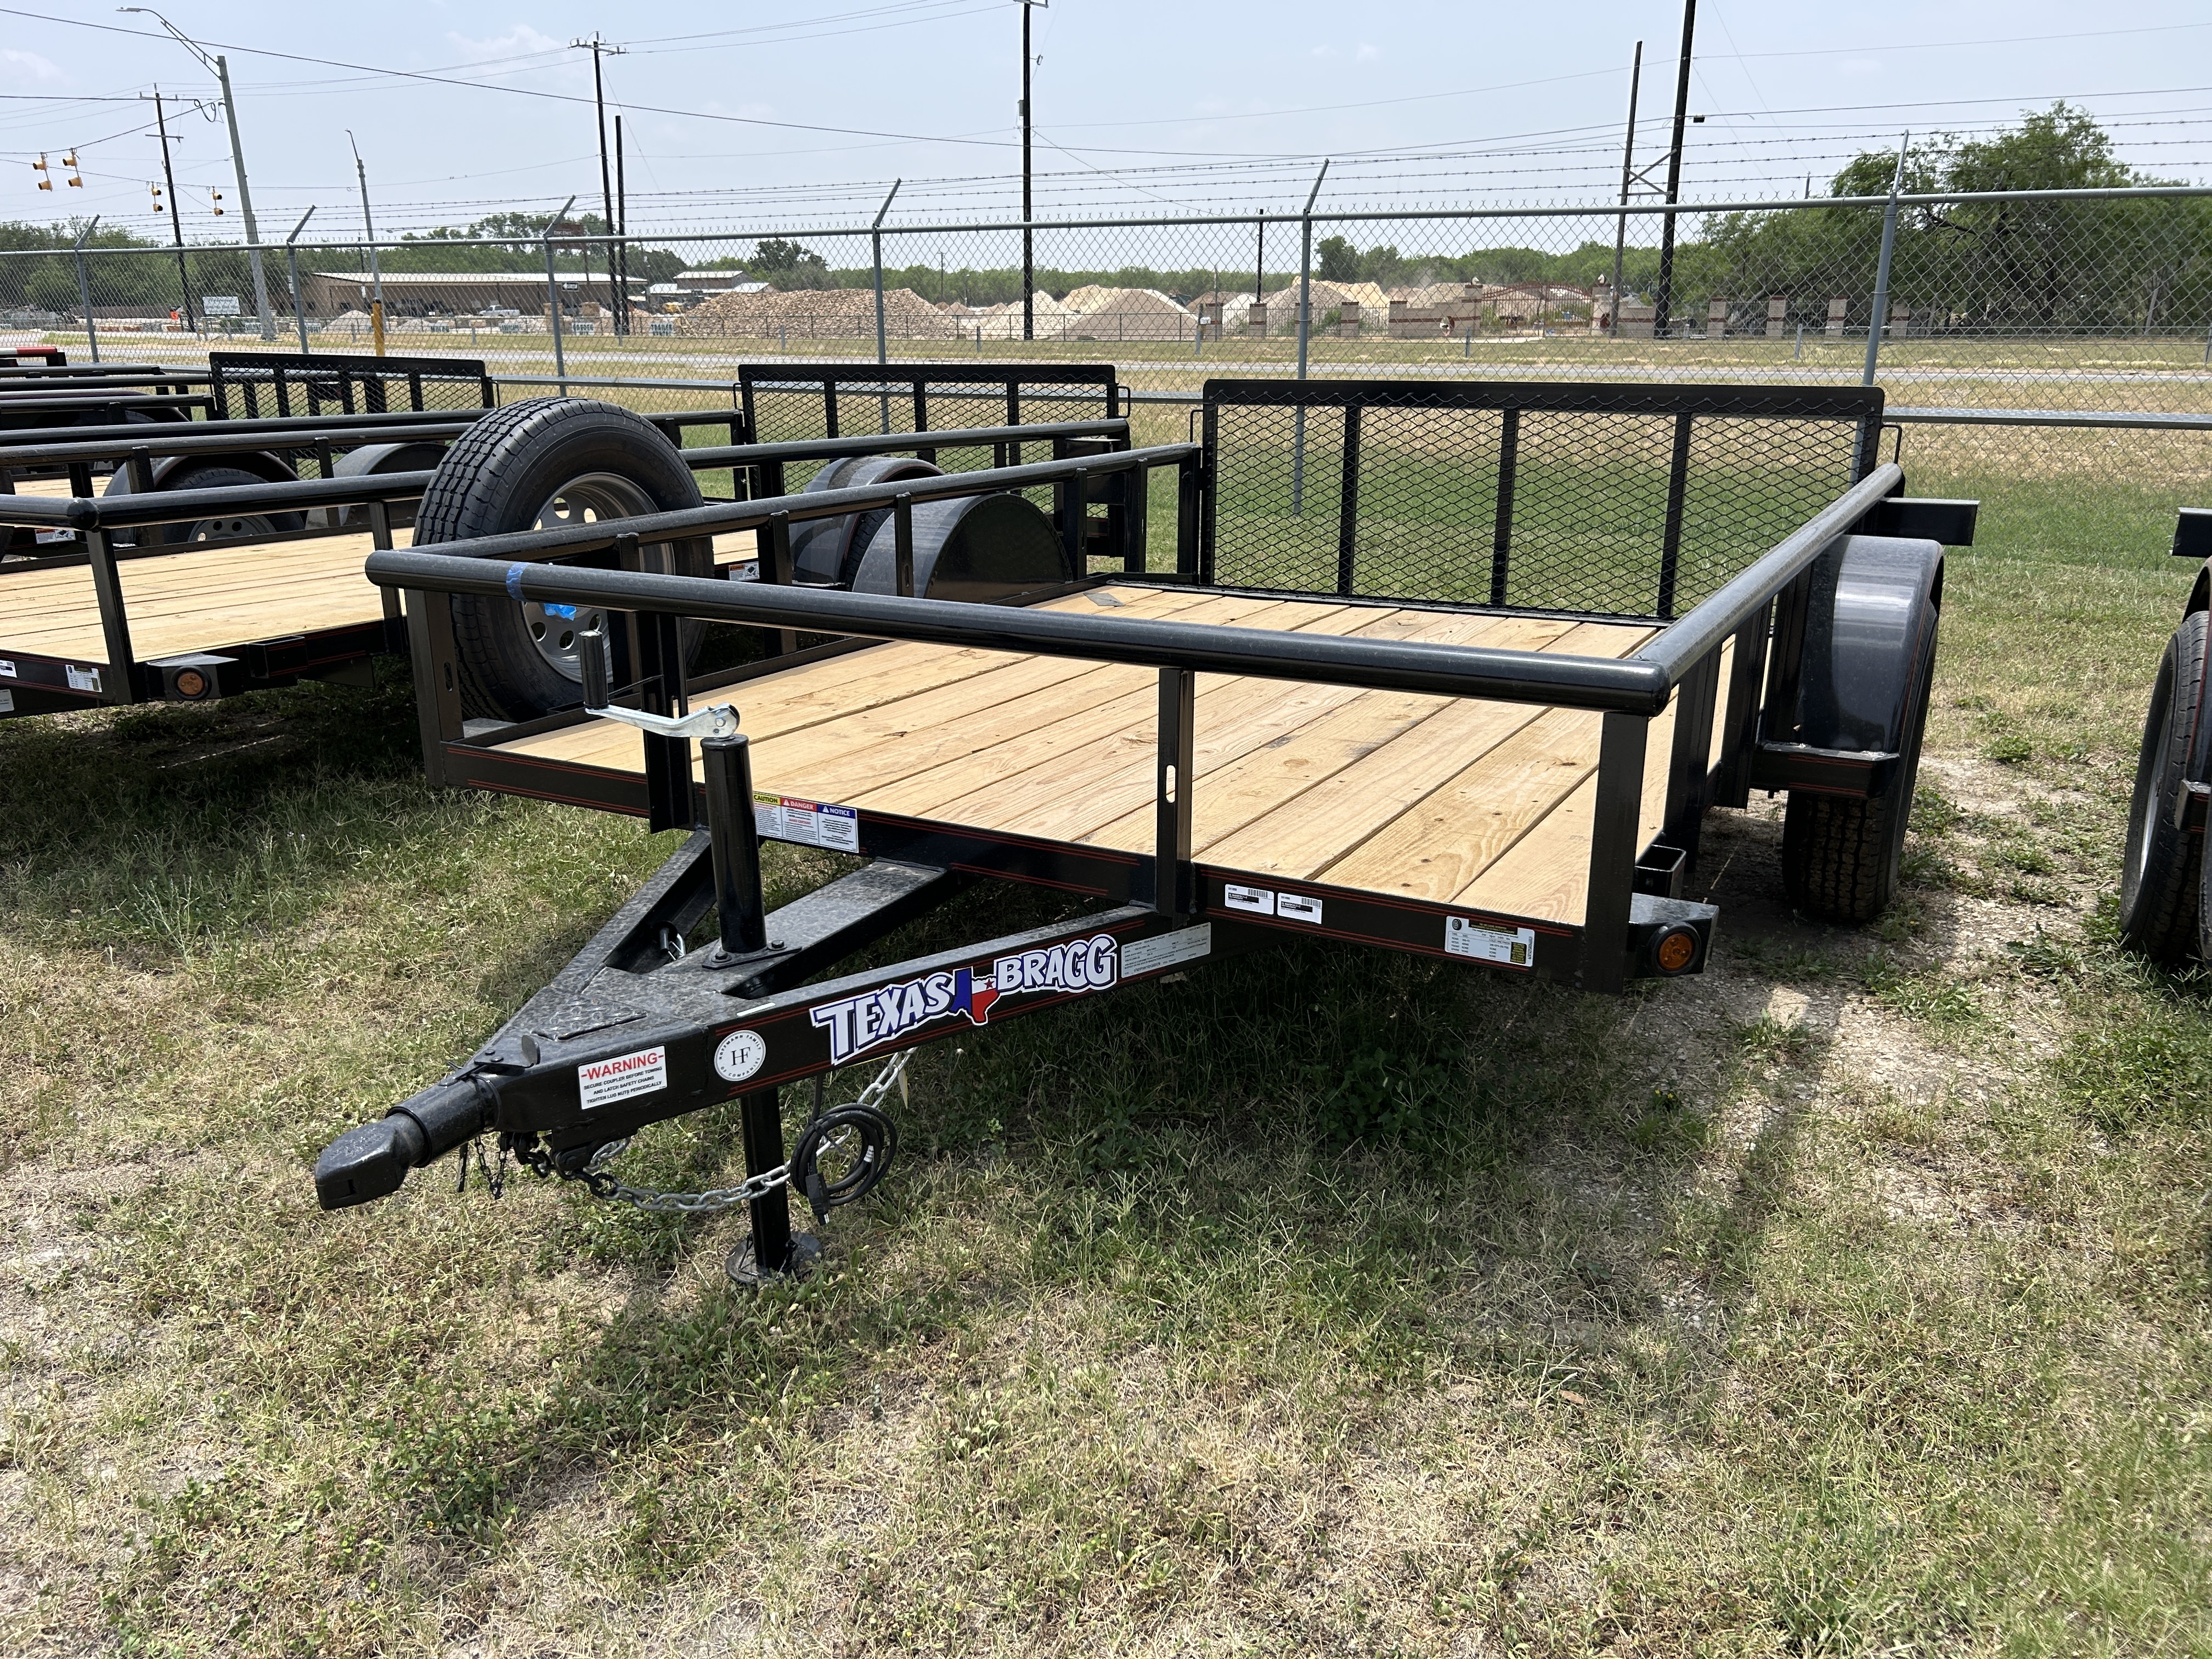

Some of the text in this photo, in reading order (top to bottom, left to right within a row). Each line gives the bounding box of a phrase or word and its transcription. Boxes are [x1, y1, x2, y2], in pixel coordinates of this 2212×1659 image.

[753, 794, 778, 804] CAUTION
[790, 800, 814, 810] DANGER
[830, 808, 850, 816] NOTICE
[811, 973, 955, 1064] TEXAS
[994, 934, 1116, 994] BRAGG
[746, 1035, 761, 1050] FAMILY
[731, 1047, 751, 1066] HF
[729, 1057, 760, 1077] COMPANIES
[584, 1066, 663, 1090] SECURE COUPLER BEFORE TOWING
[619, 1080, 637, 1088] SAFETY
[637, 1075, 654, 1084] CHAINS
[586, 1095, 607, 1104] TIGHTEN
[630, 1080, 662, 1093] PERIODICALLY
